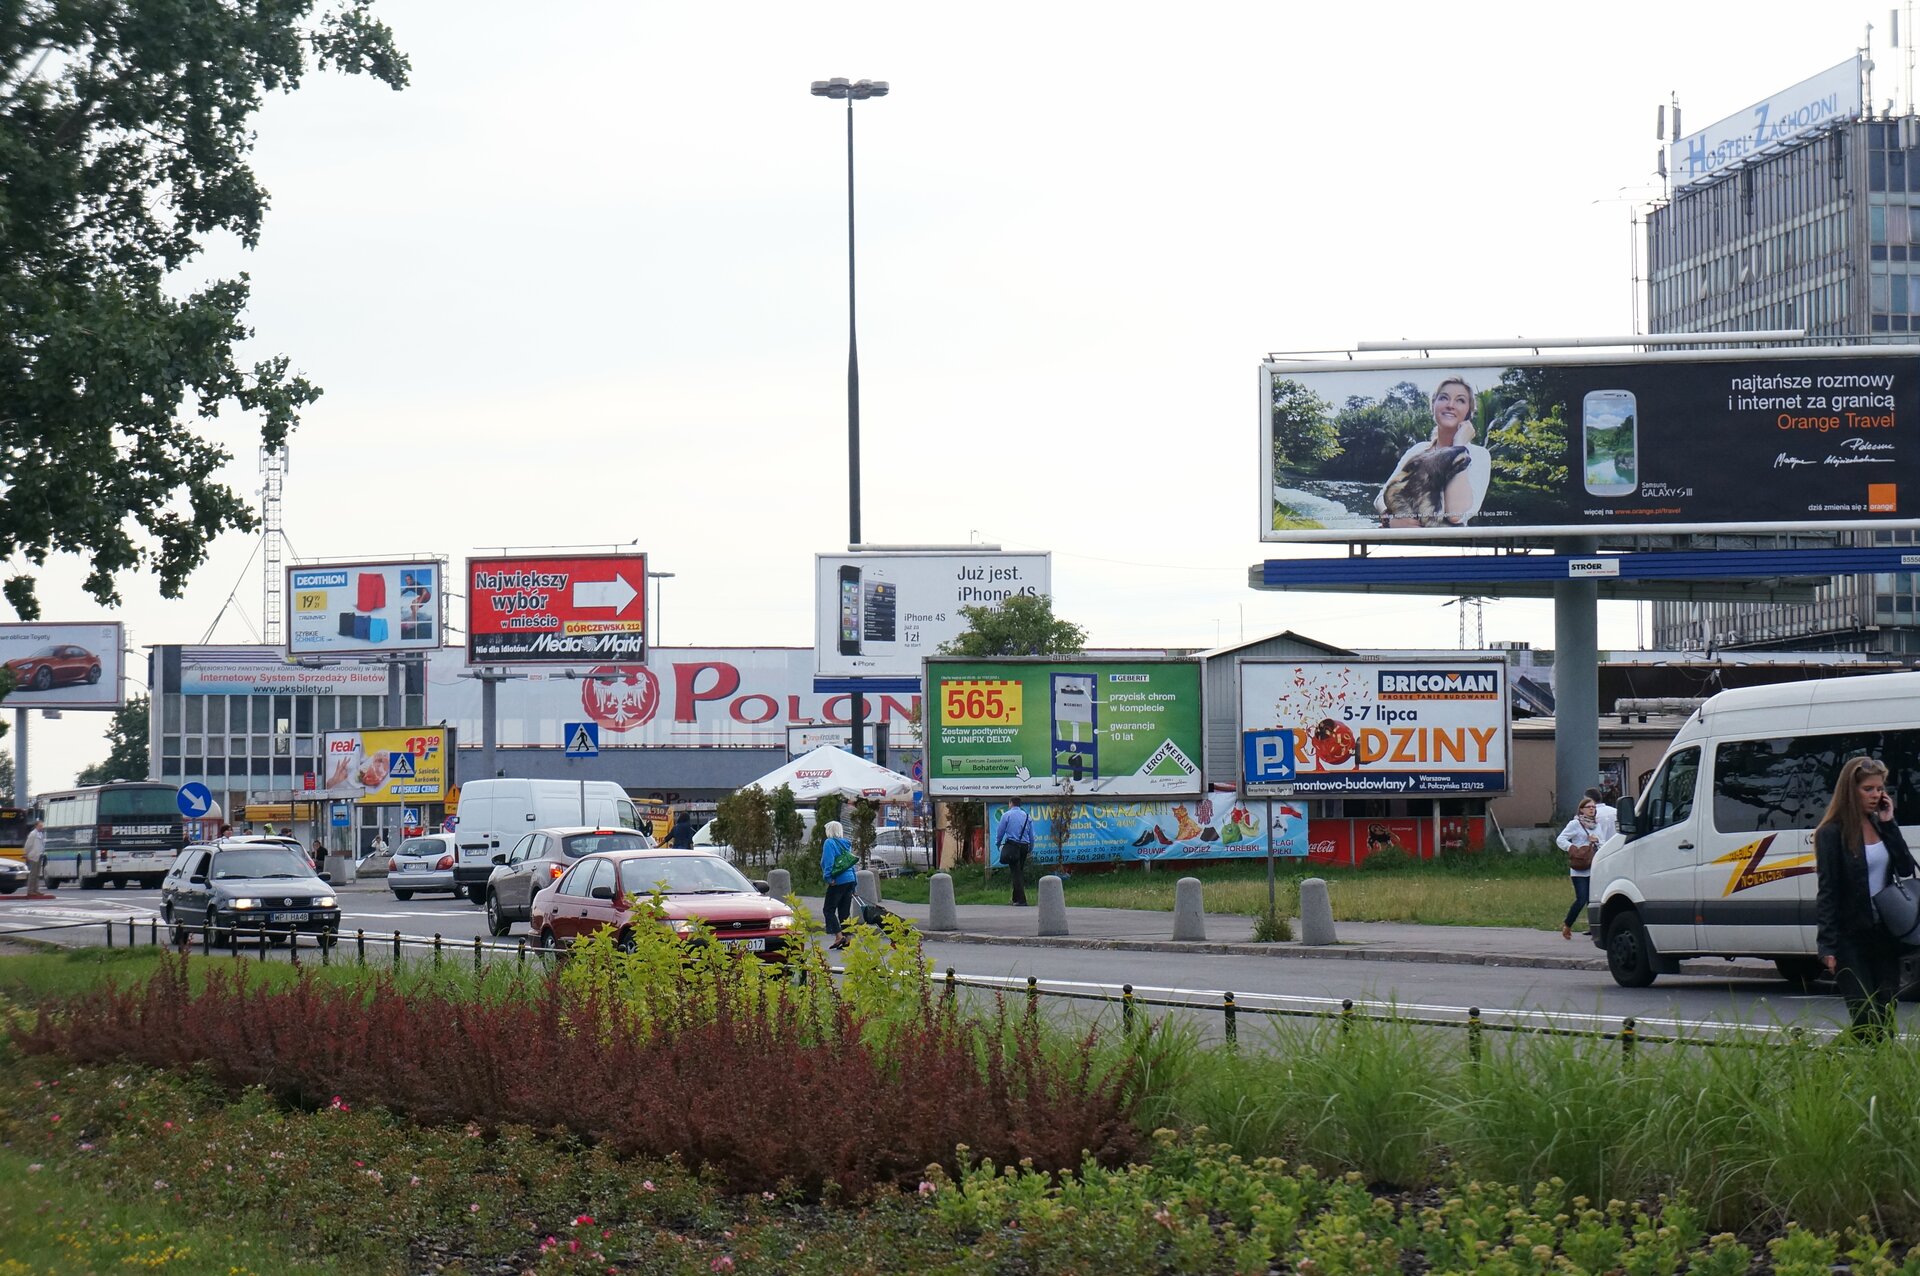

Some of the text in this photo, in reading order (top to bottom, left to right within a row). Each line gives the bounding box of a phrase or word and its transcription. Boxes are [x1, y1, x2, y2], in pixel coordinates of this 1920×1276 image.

[1688, 93, 1838, 179] HOSTEL ZACHODNI
[1731, 374, 1895, 394] najtańsze rozmowy
[1728, 391, 1896, 412] i internet za granicą
[1777, 412, 1896, 433] Orange Travel
[1641, 481, 1667, 490] Samsung
[1641, 489, 1676, 498] GALAXY
[1584, 508, 1604, 517] więcej
[1615, 507, 1681, 516] www.orange.pl/travel
[1851, 503, 1862, 513] się
[1869, 503, 1894, 511] orange
[1571, 562, 1602, 571] STRÖER
[957, 565, 1023, 583] Już jest.
[296, 574, 346, 586] DECATHLON
[475, 570, 569, 592] Największy
[957, 586, 1012, 602] iPhone
[301, 595, 313, 609] 19
[492, 589, 548, 614] wybór
[501, 613, 559, 629] w mieście
[904, 612, 946, 622] iPhone 4S
[566, 622, 640, 634] GÓRCZEWSKA 212
[9, 632, 29, 641] oblicze
[31, 633, 51, 641] Toyoty
[529, 633, 643, 653] Media Markt
[475, 644, 529, 654] Nie dla idiotów!
[200, 673, 386, 684] Internetowy System Sprzedaży Biletów
[1382, 673, 1494, 692] BRICOMAN
[253, 684, 334, 694] www.pksbilety.pl
[672, 661, 922, 724] POLON
[1109, 692, 1176, 704] przycisk chrom
[1119, 703, 1165, 713] komplecie
[1343, 705, 1418, 725] 5-7 lipca
[941, 727, 1019, 738] Zestaw podtynkowy
[1110, 721, 1155, 733] gwarancja
[941, 735, 1012, 744] WC UNIFIX DELTA
[1110, 733, 1134, 741] 10 lat
[1142, 742, 1196, 776] LEROY MERLIN
[1256, 736, 1285, 776] P
[972, 764, 1010, 772] Bohaterów
[942, 784, 959, 792] Kupuj
[959, 783, 981, 791] również
[990, 783, 1042, 791] www.leroymerlin.pl
[1293, 777, 1407, 793] montowo-budowlany
[1419, 782, 1427, 790] ul.
[1461, 782, 1485, 790] 121/125
[1030, 804, 1090, 821] UWGA
[112, 825, 173, 836] PHILIBERT
[1066, 821, 1093, 830] abat
[1272, 839, 1294, 847] FLAGI
[1137, 847, 1167, 855] OBUWIE
[1182, 845, 1212, 854] ODZIEŻ
[1225, 845, 1261, 853] TOREBKI
